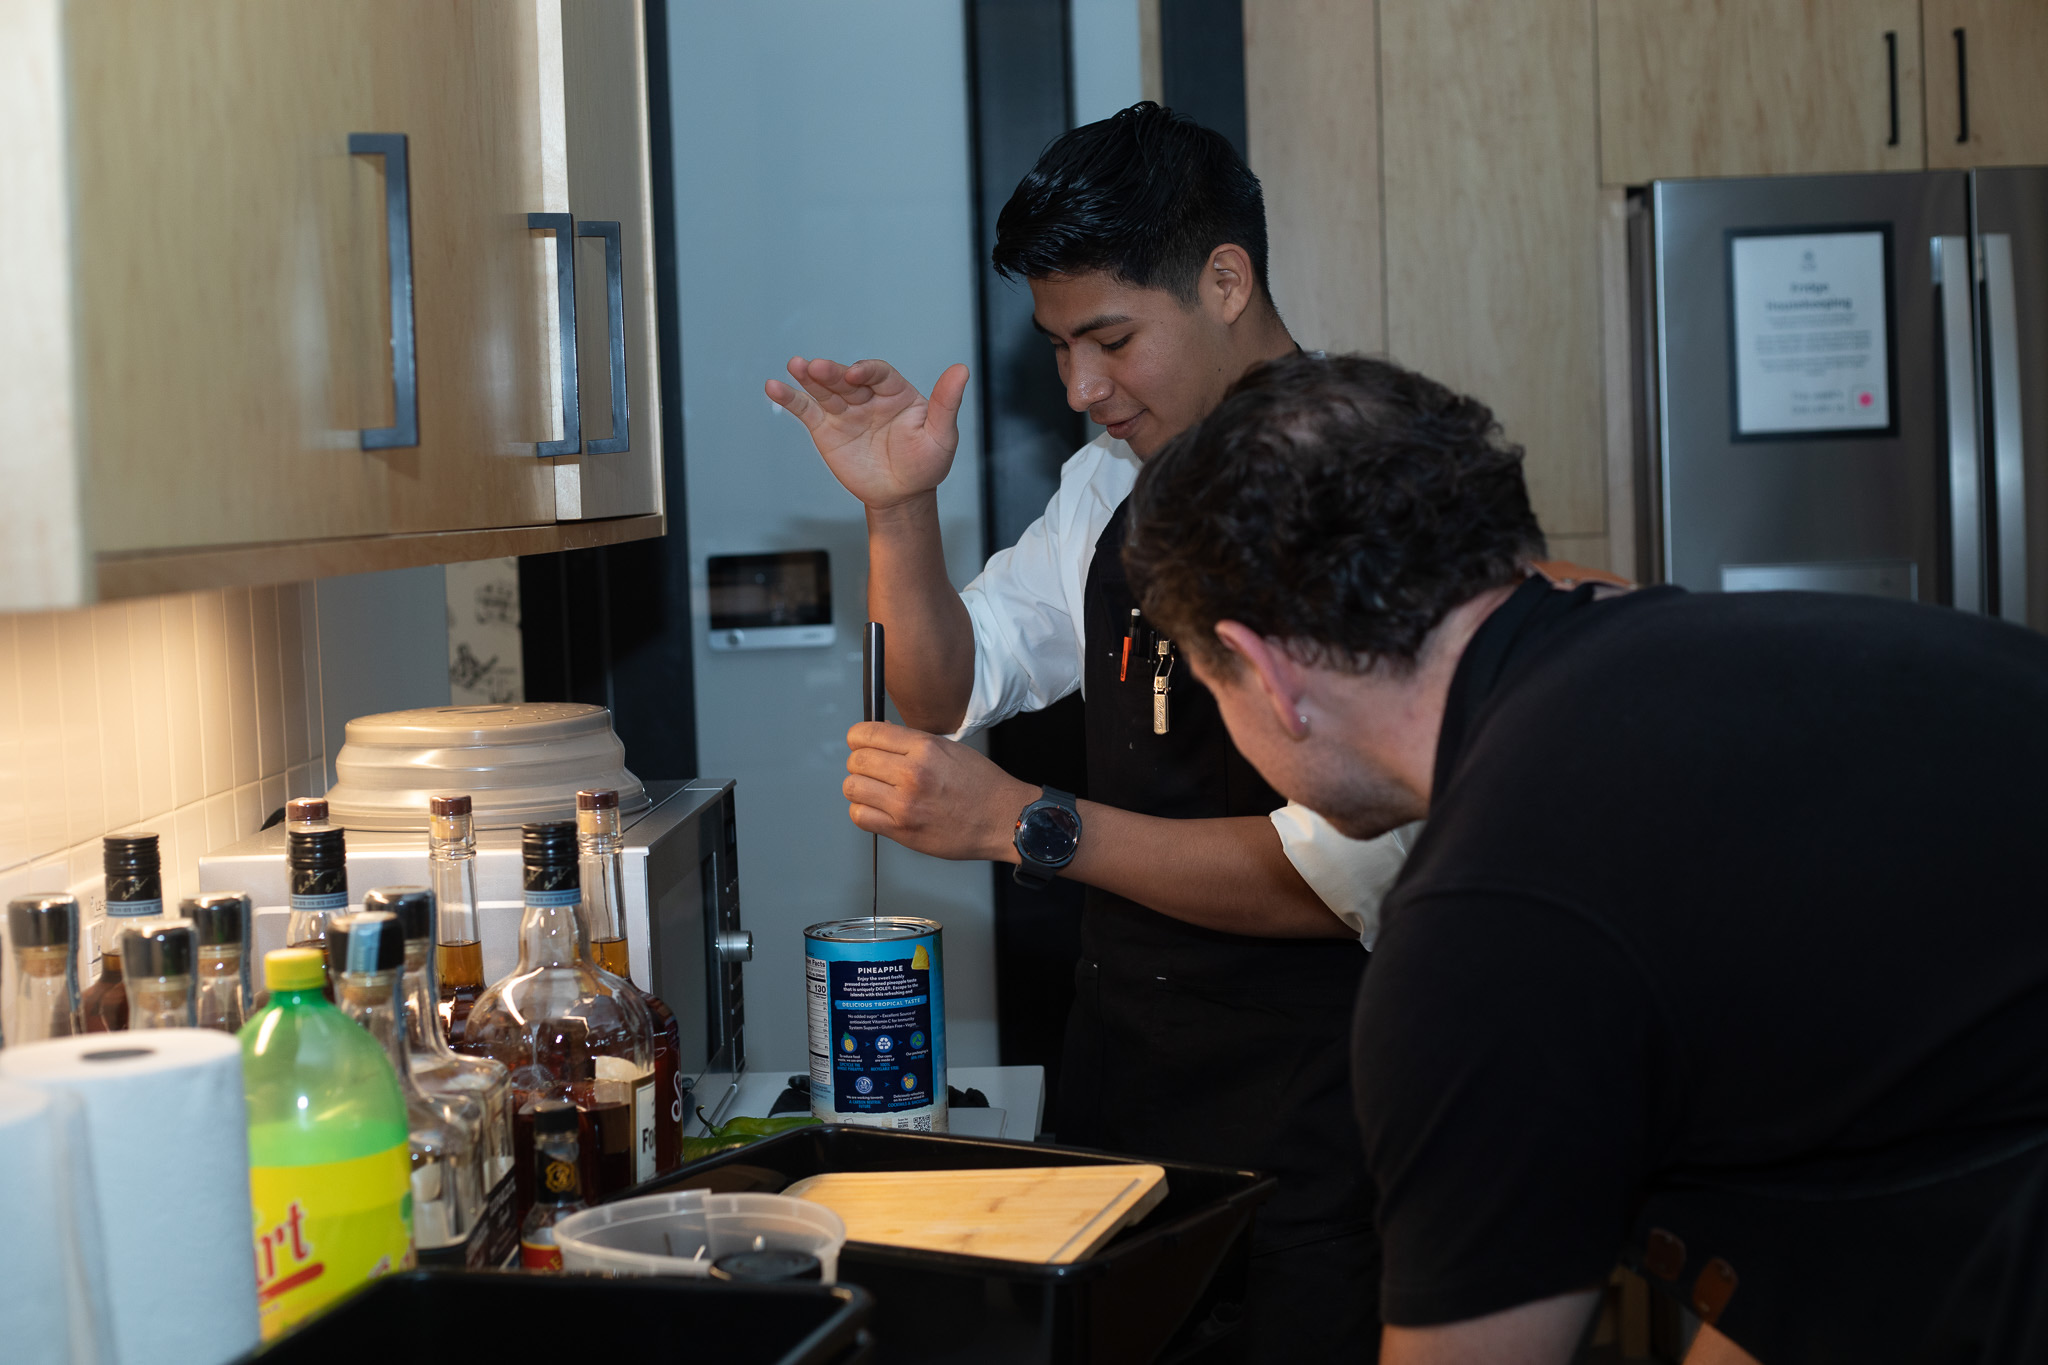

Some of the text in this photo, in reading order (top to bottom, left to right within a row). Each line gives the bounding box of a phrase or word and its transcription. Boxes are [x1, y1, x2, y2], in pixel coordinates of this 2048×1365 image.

[812, 959, 826, 968] Facts
[858, 965, 904, 974] PINEAPPLE
[814, 984, 826, 994] 130
